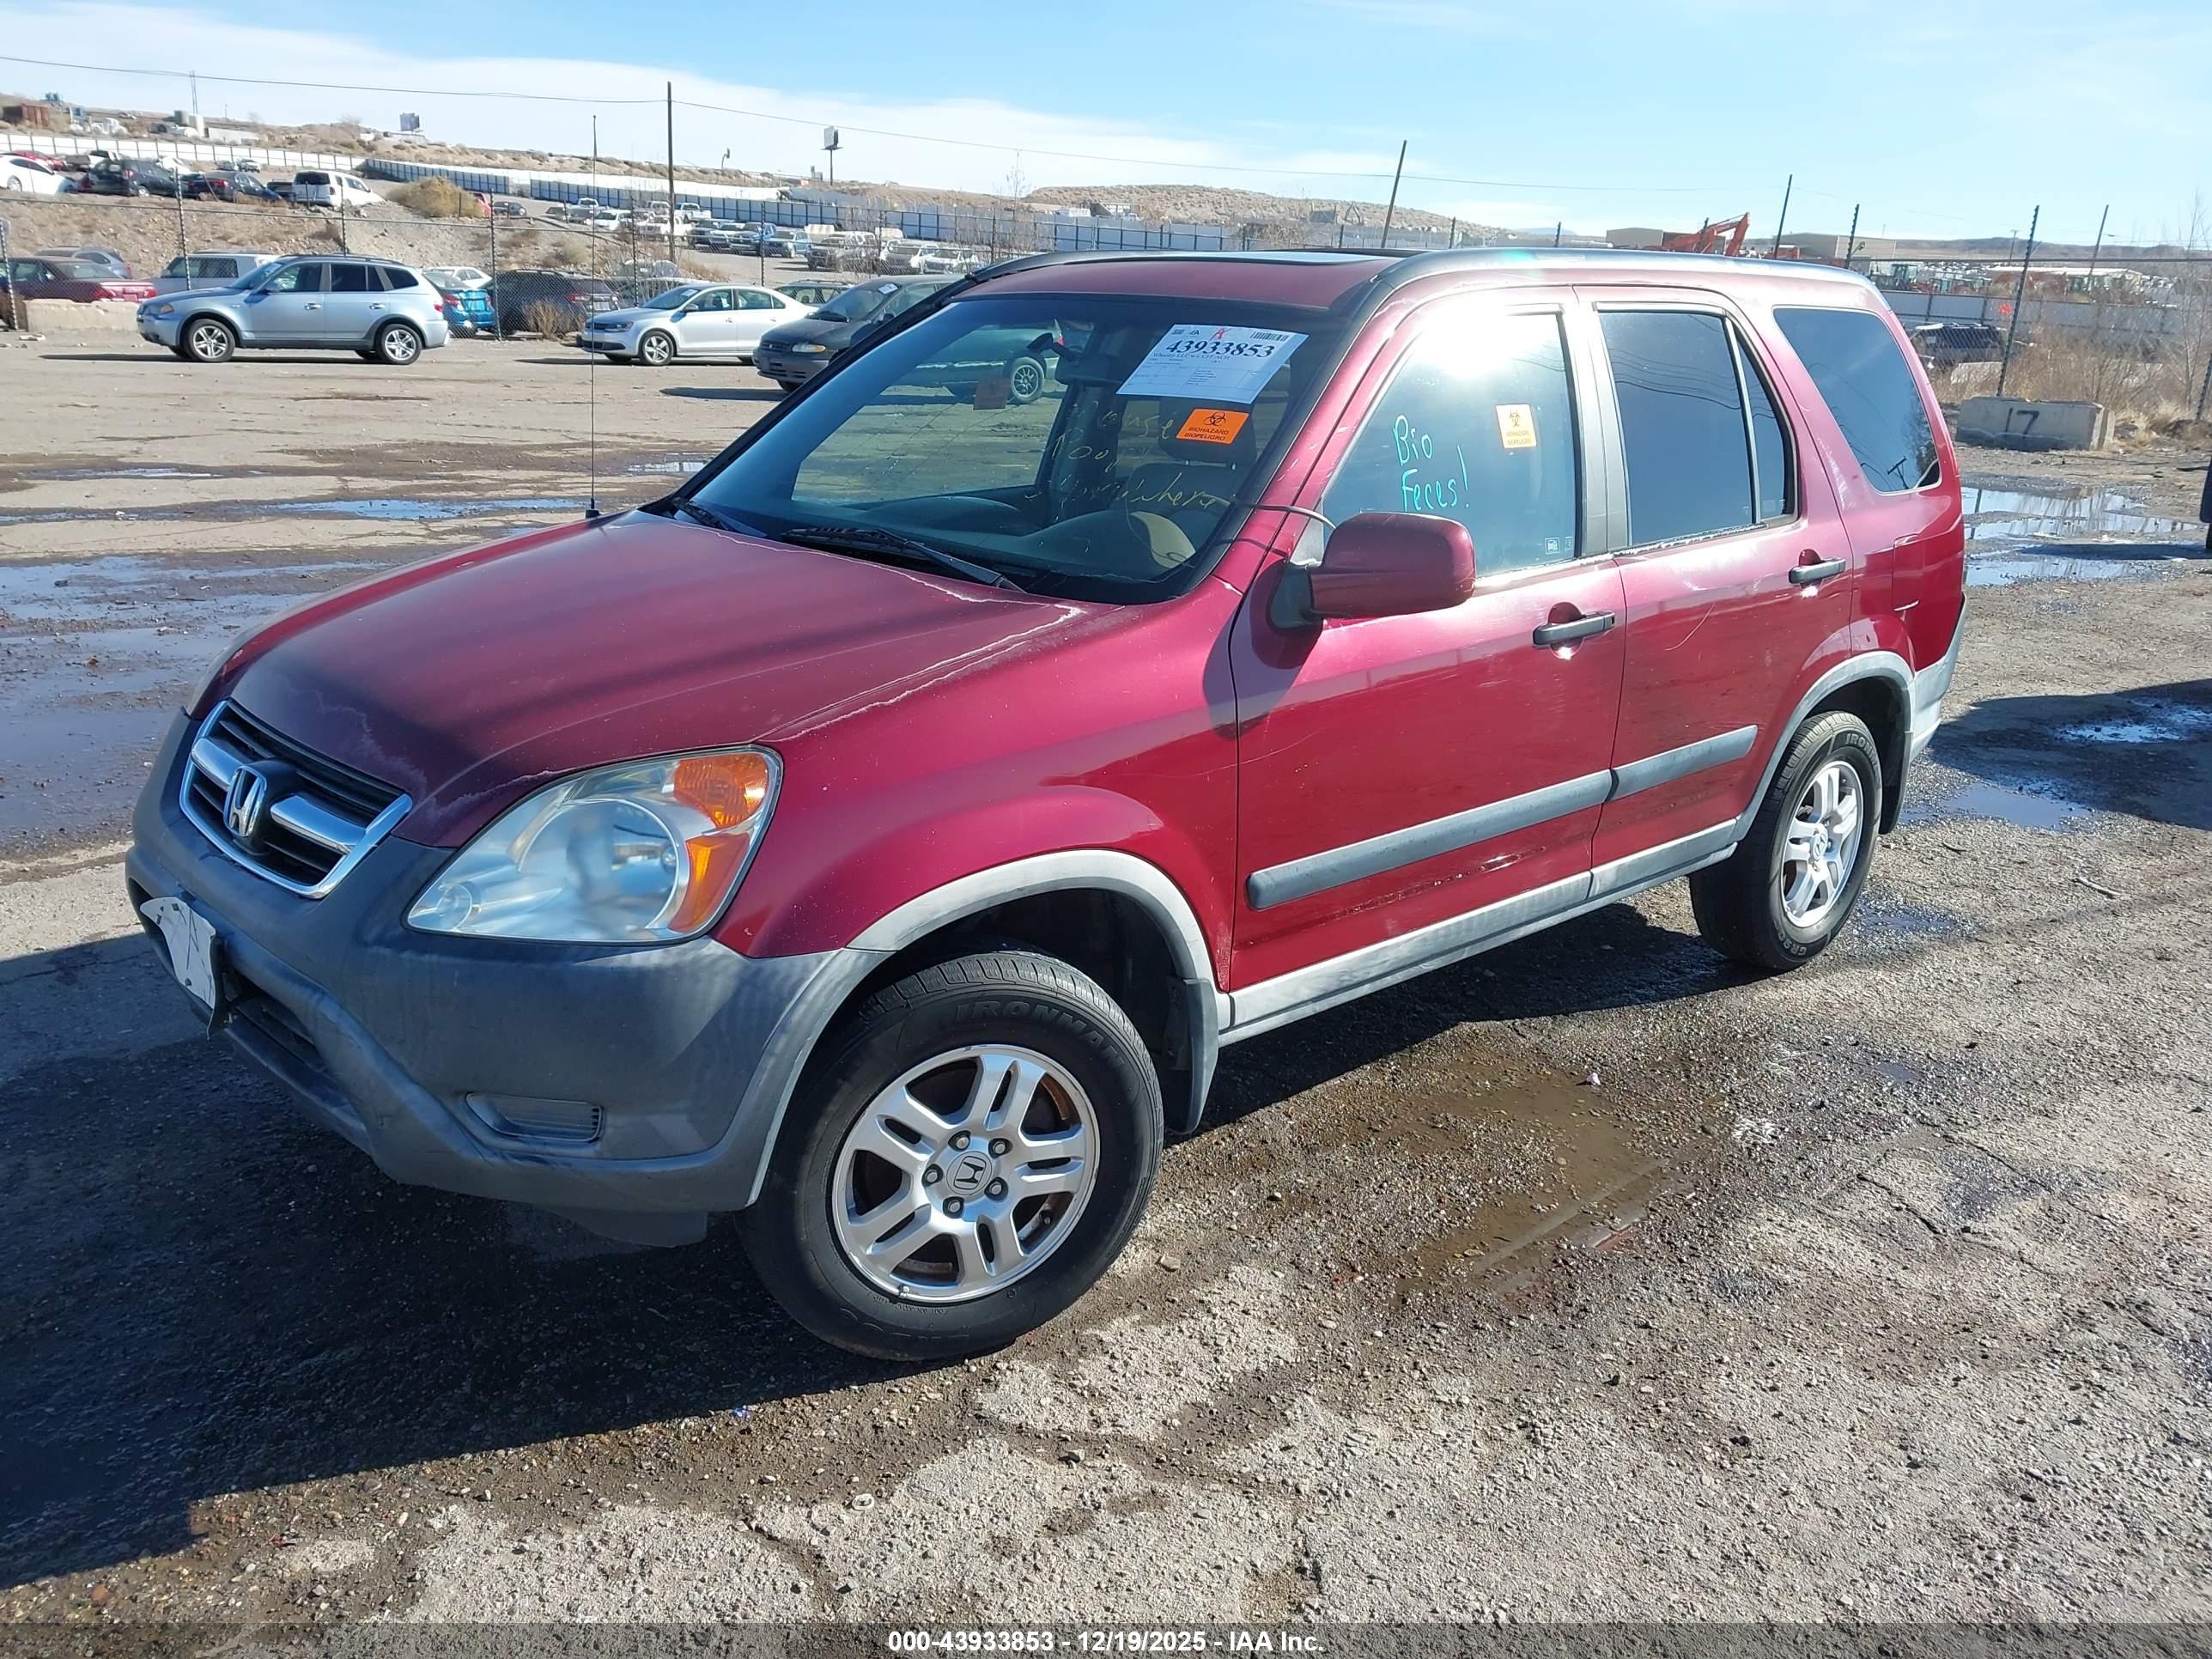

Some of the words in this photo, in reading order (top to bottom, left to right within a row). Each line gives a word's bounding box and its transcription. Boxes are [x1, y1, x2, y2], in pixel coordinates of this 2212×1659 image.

[1166, 340, 1275, 358] 43933853
[1393, 415, 1432, 466] Bio
[2004, 407, 2040, 440] 17
[1401, 445, 1469, 514] Feces!
